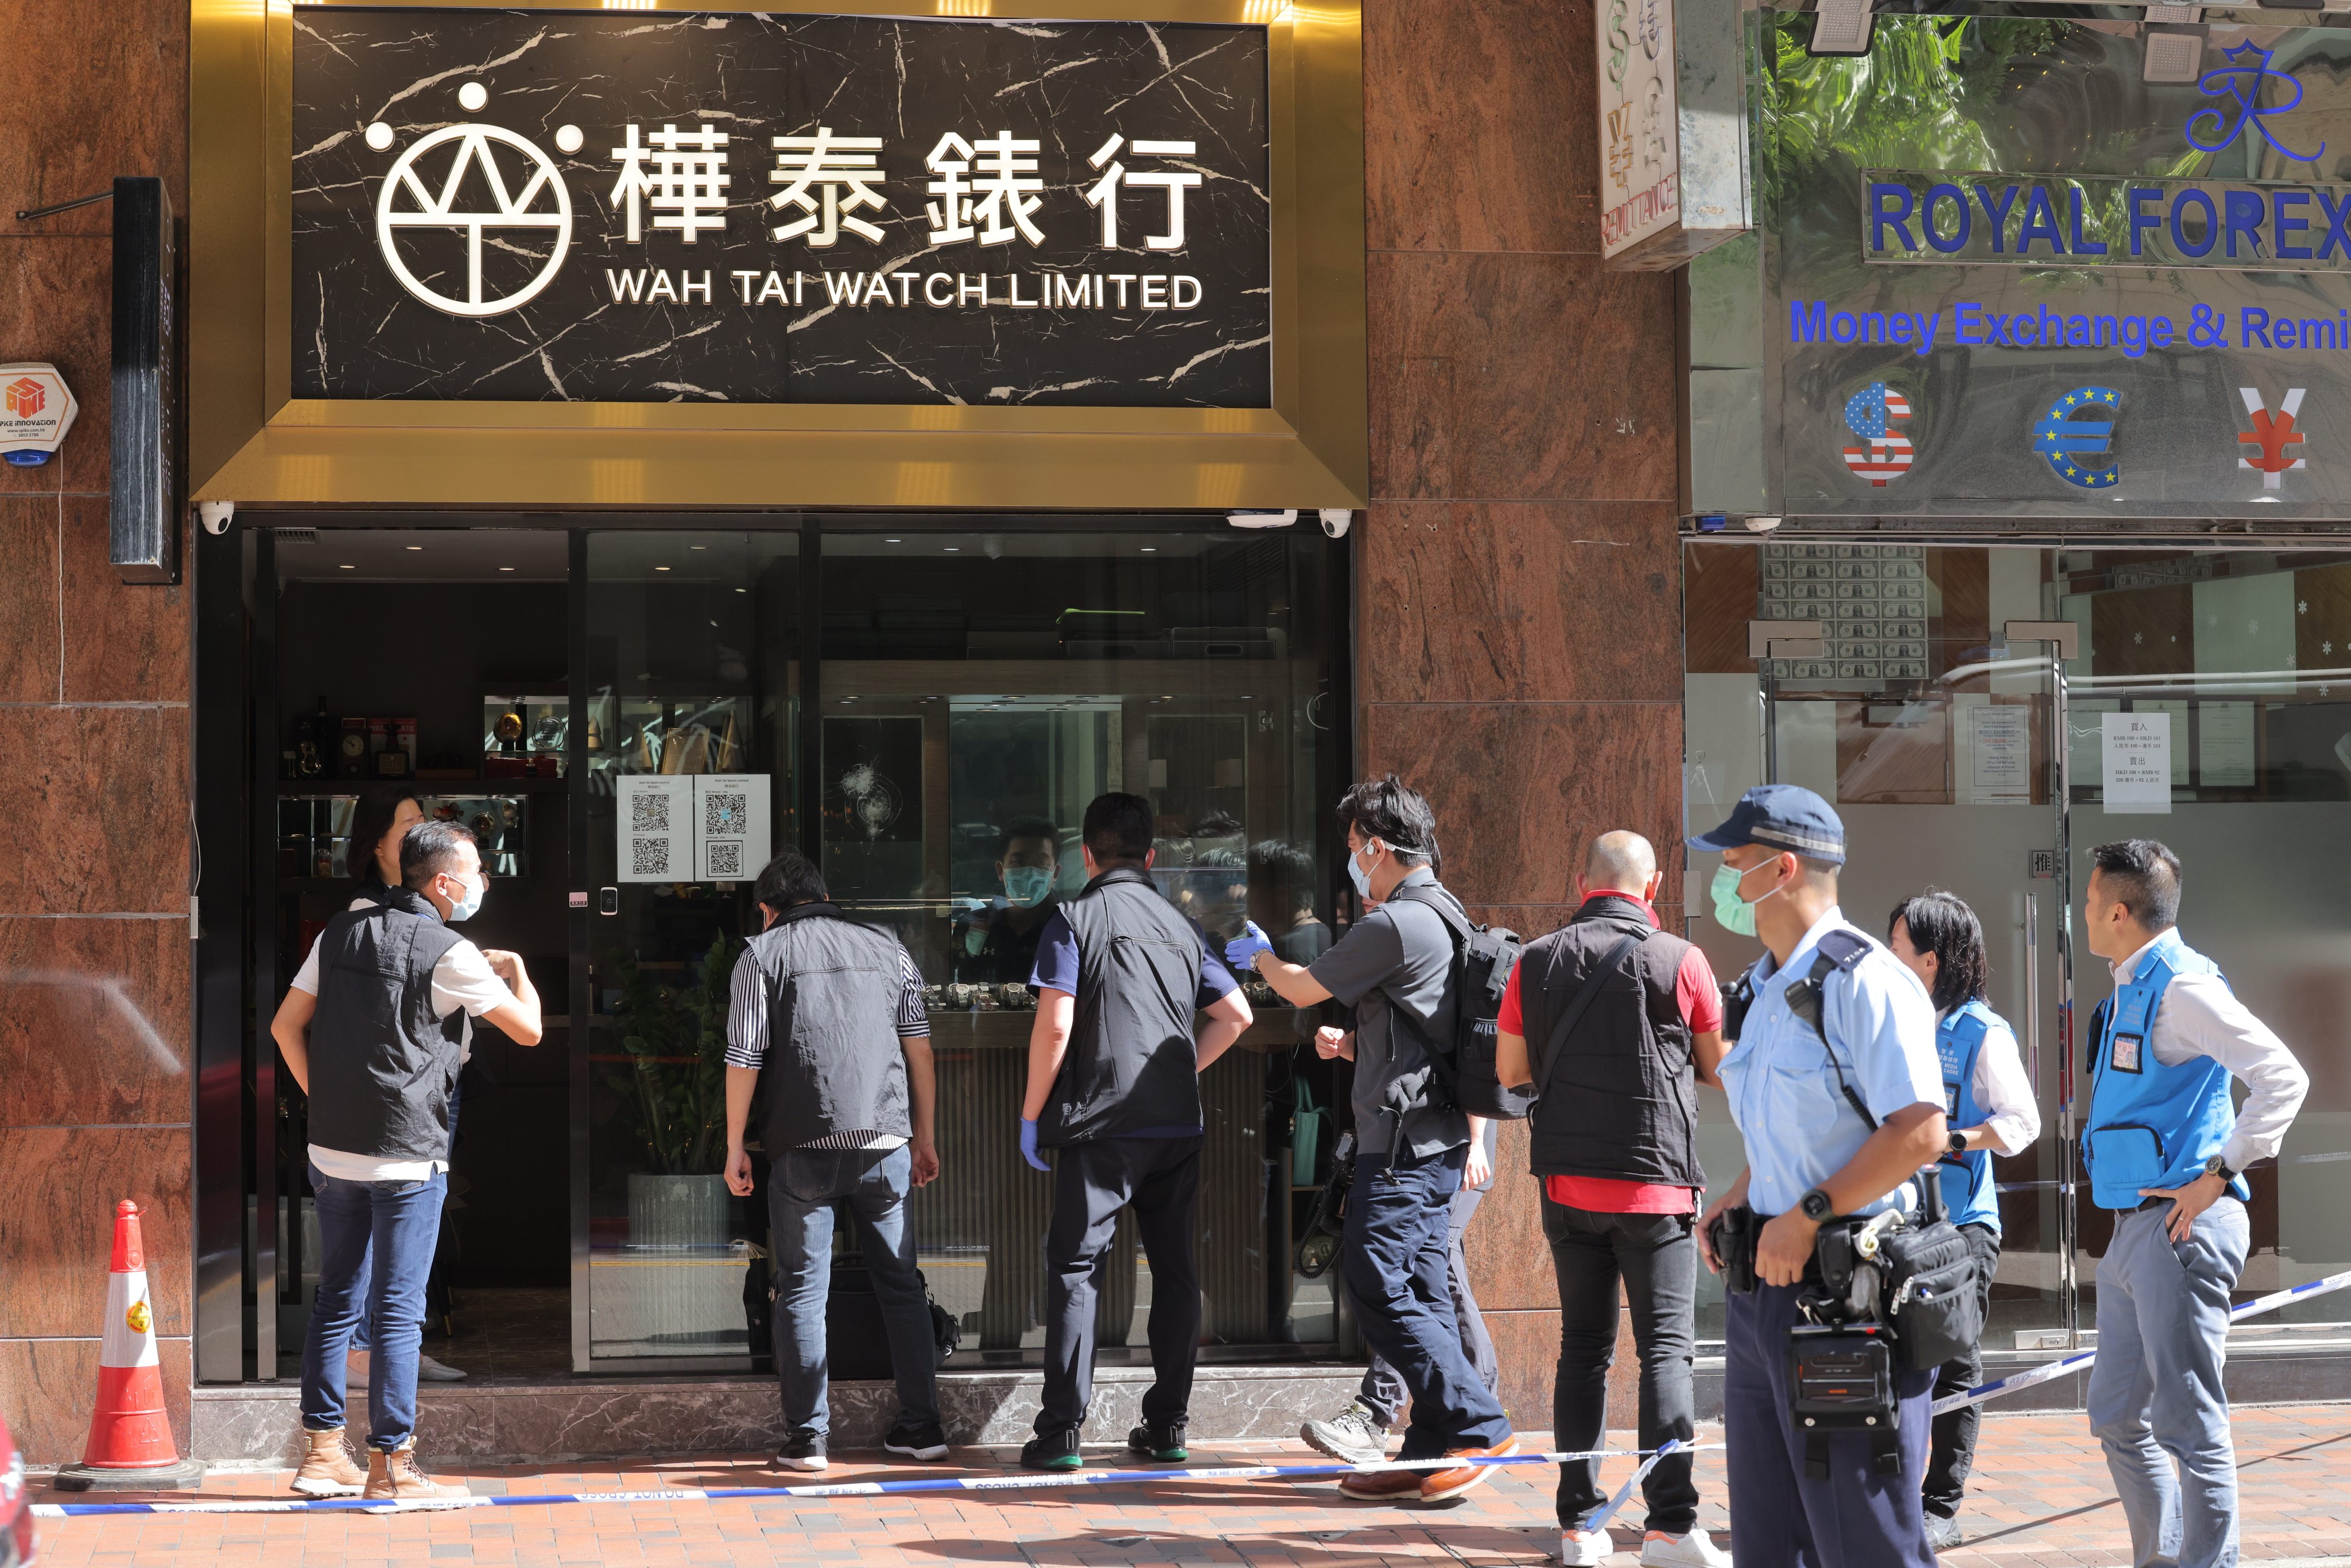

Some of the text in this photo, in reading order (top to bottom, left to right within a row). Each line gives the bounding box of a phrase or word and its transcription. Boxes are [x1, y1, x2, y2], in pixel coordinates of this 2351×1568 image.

[609, 124, 1202, 251] 樺泰錶行
[1600, 172, 1677, 249] REMITTANCE
[1871, 183, 2351, 260] ROYAL FOREX
[605, 269, 1202, 310] WAH TAI WATCH LIMITED
[1790, 300, 2351, 358] Money Exchange & Remi
[2131, 723, 2147, 731] 買入
[2129, 756, 2146, 765] 賣出
[2035, 853, 2051, 872] 推
